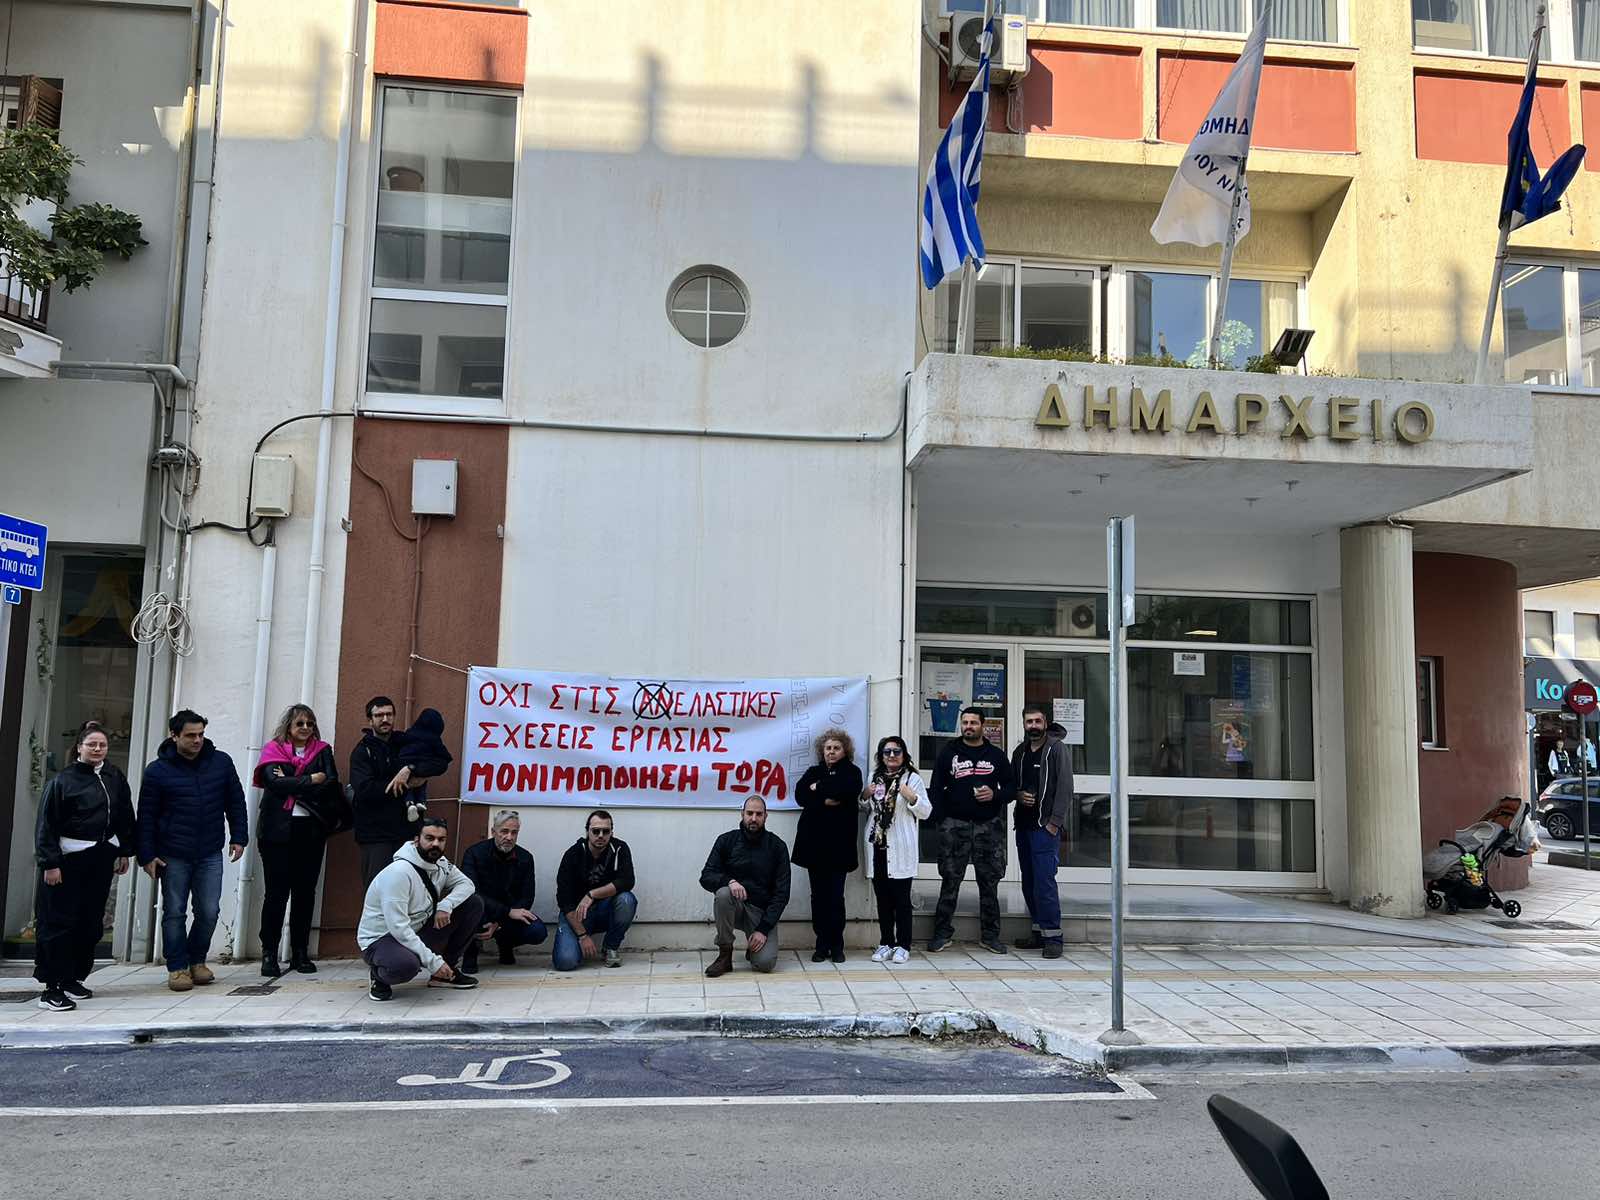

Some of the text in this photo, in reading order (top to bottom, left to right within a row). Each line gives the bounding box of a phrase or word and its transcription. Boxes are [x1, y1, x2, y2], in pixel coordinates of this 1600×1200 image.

[1035, 383, 1436, 444] ΔΗΜΑΡΧΕΙΟ
[0, 557, 37, 577] ΤΙΚΟ ΚΤΕΛ
[10, 589, 15, 600] 7
[479, 682, 532, 708] ΟΧΙ
[549, 684, 622, 715] ΣΤΙΣ
[478, 722, 731, 753] ΣΧΕΣΕΙΣ ΕΡΓΑΣΙΑΣ
[468, 759, 786, 801] ΜΟΝΙΜΟΠΟΙΗΣΗ ΤΩΡΑ
